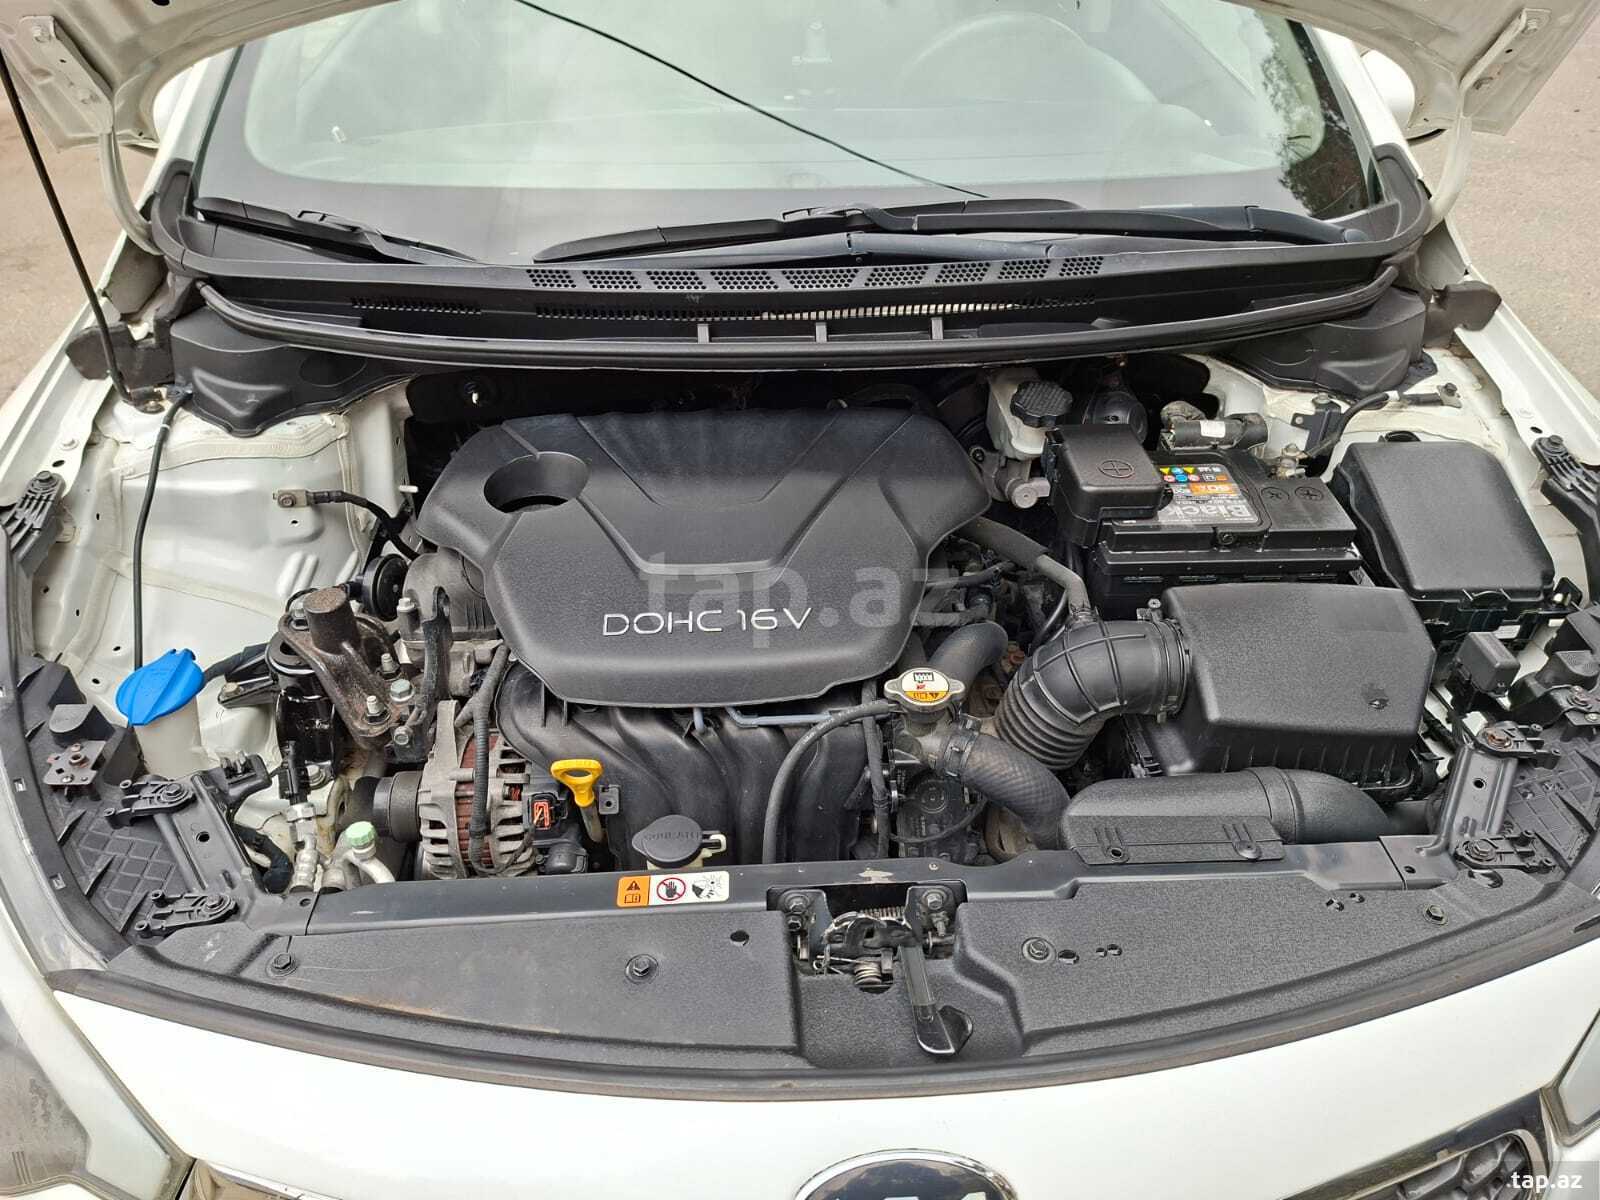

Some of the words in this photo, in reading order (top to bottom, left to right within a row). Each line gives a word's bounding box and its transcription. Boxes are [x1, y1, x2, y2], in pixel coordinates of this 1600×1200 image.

[1168, 504, 1252, 519] Black
[602, 609, 723, 637] DOHC
[737, 607, 813, 631] 16V
